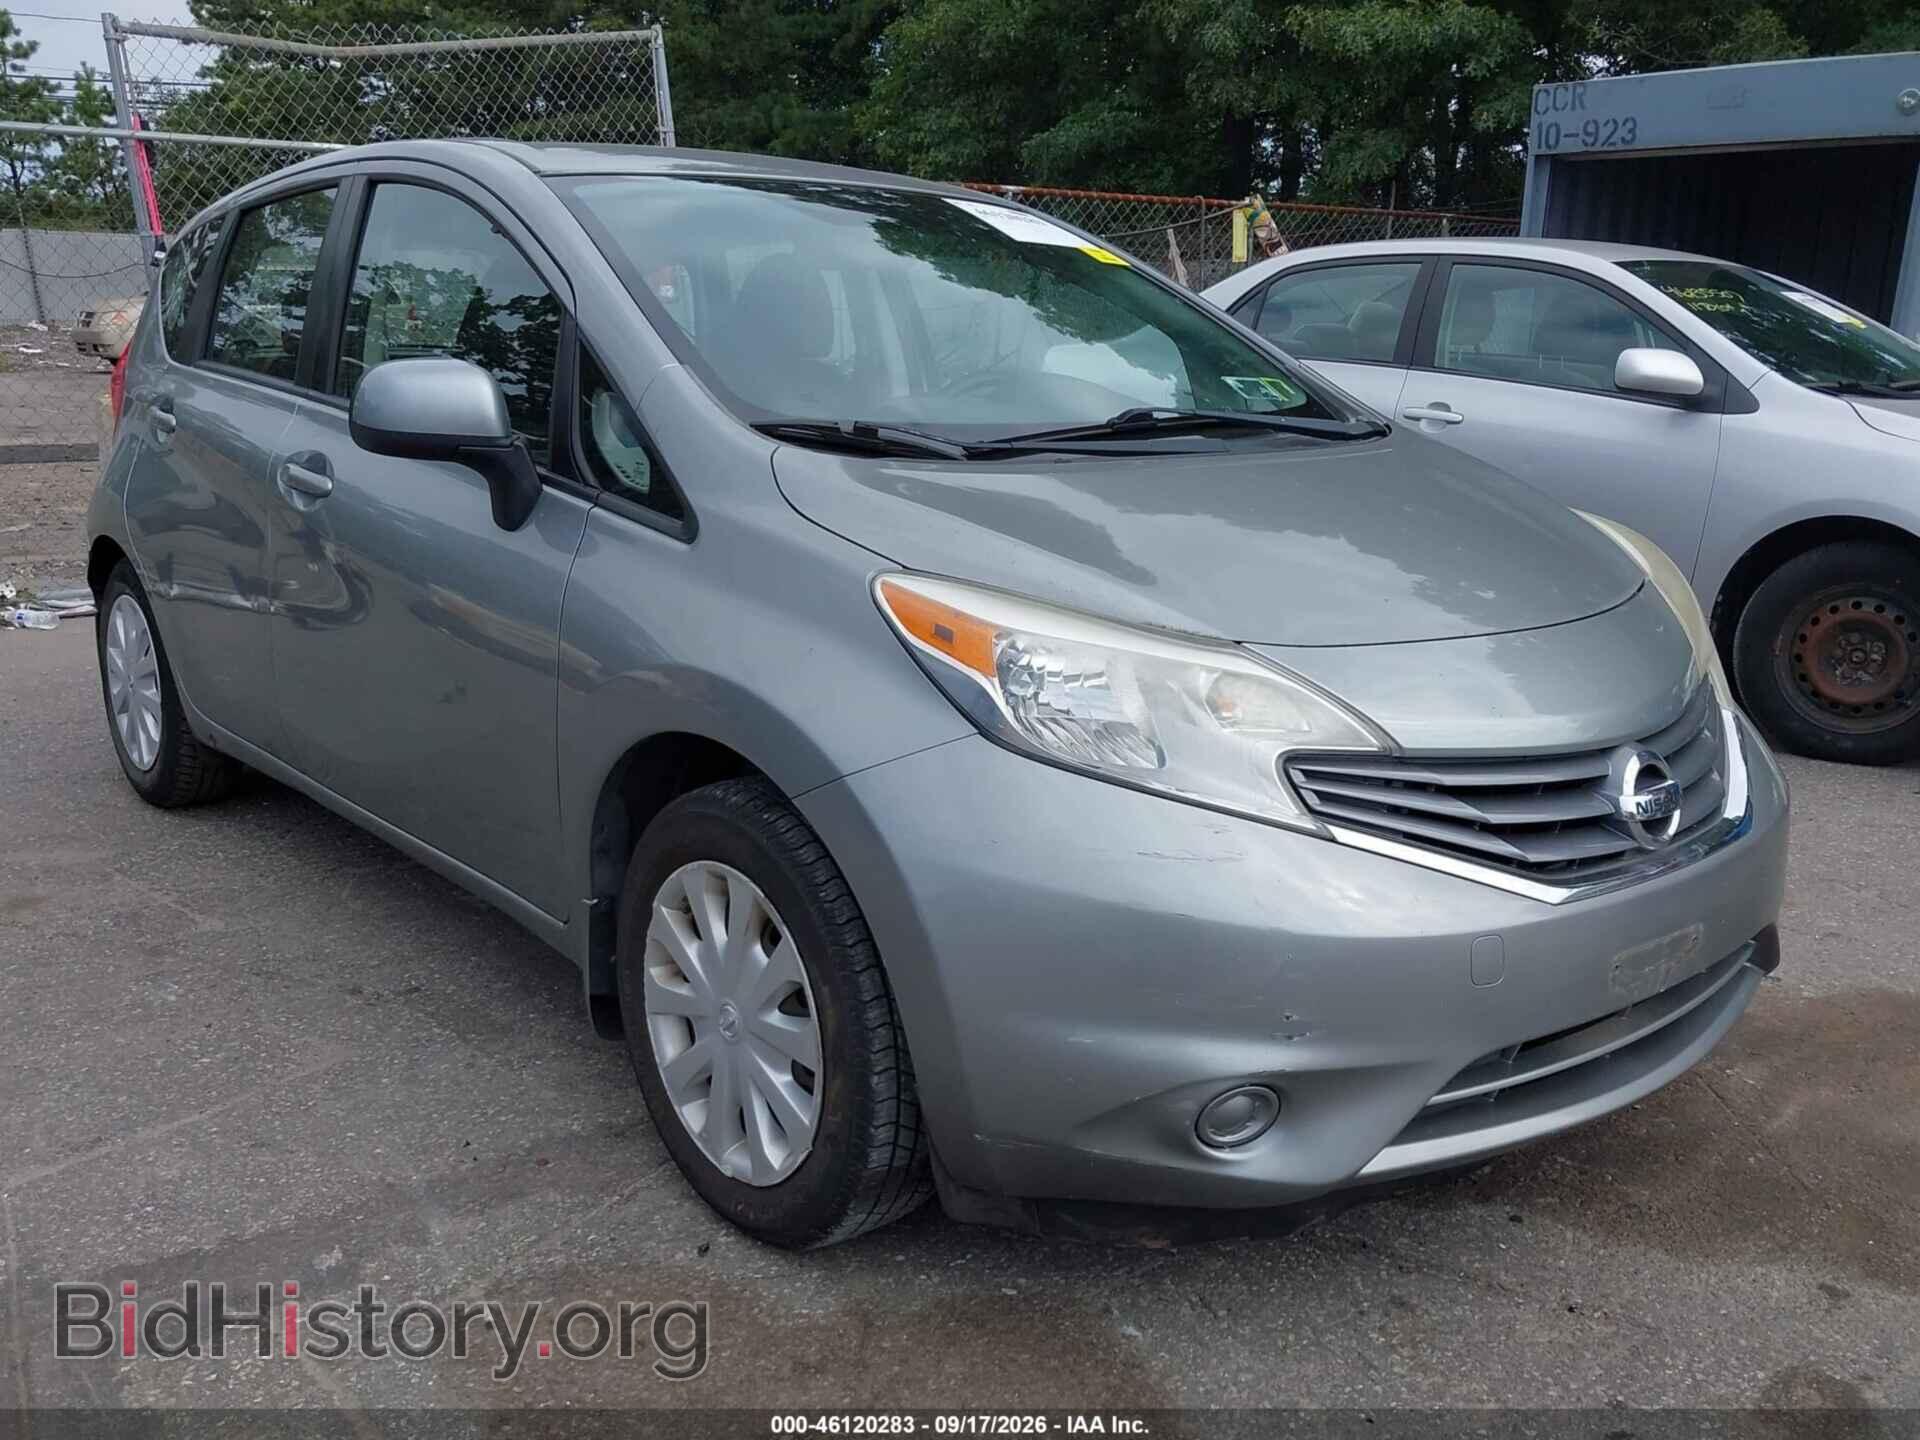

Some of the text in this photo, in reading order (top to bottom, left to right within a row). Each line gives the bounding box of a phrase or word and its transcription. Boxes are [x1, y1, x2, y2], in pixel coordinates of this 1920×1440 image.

[1534, 85, 1586, 115] CCR
[1536, 116, 1638, 150] 10-923
[1635, 785, 1680, 816] NIS
